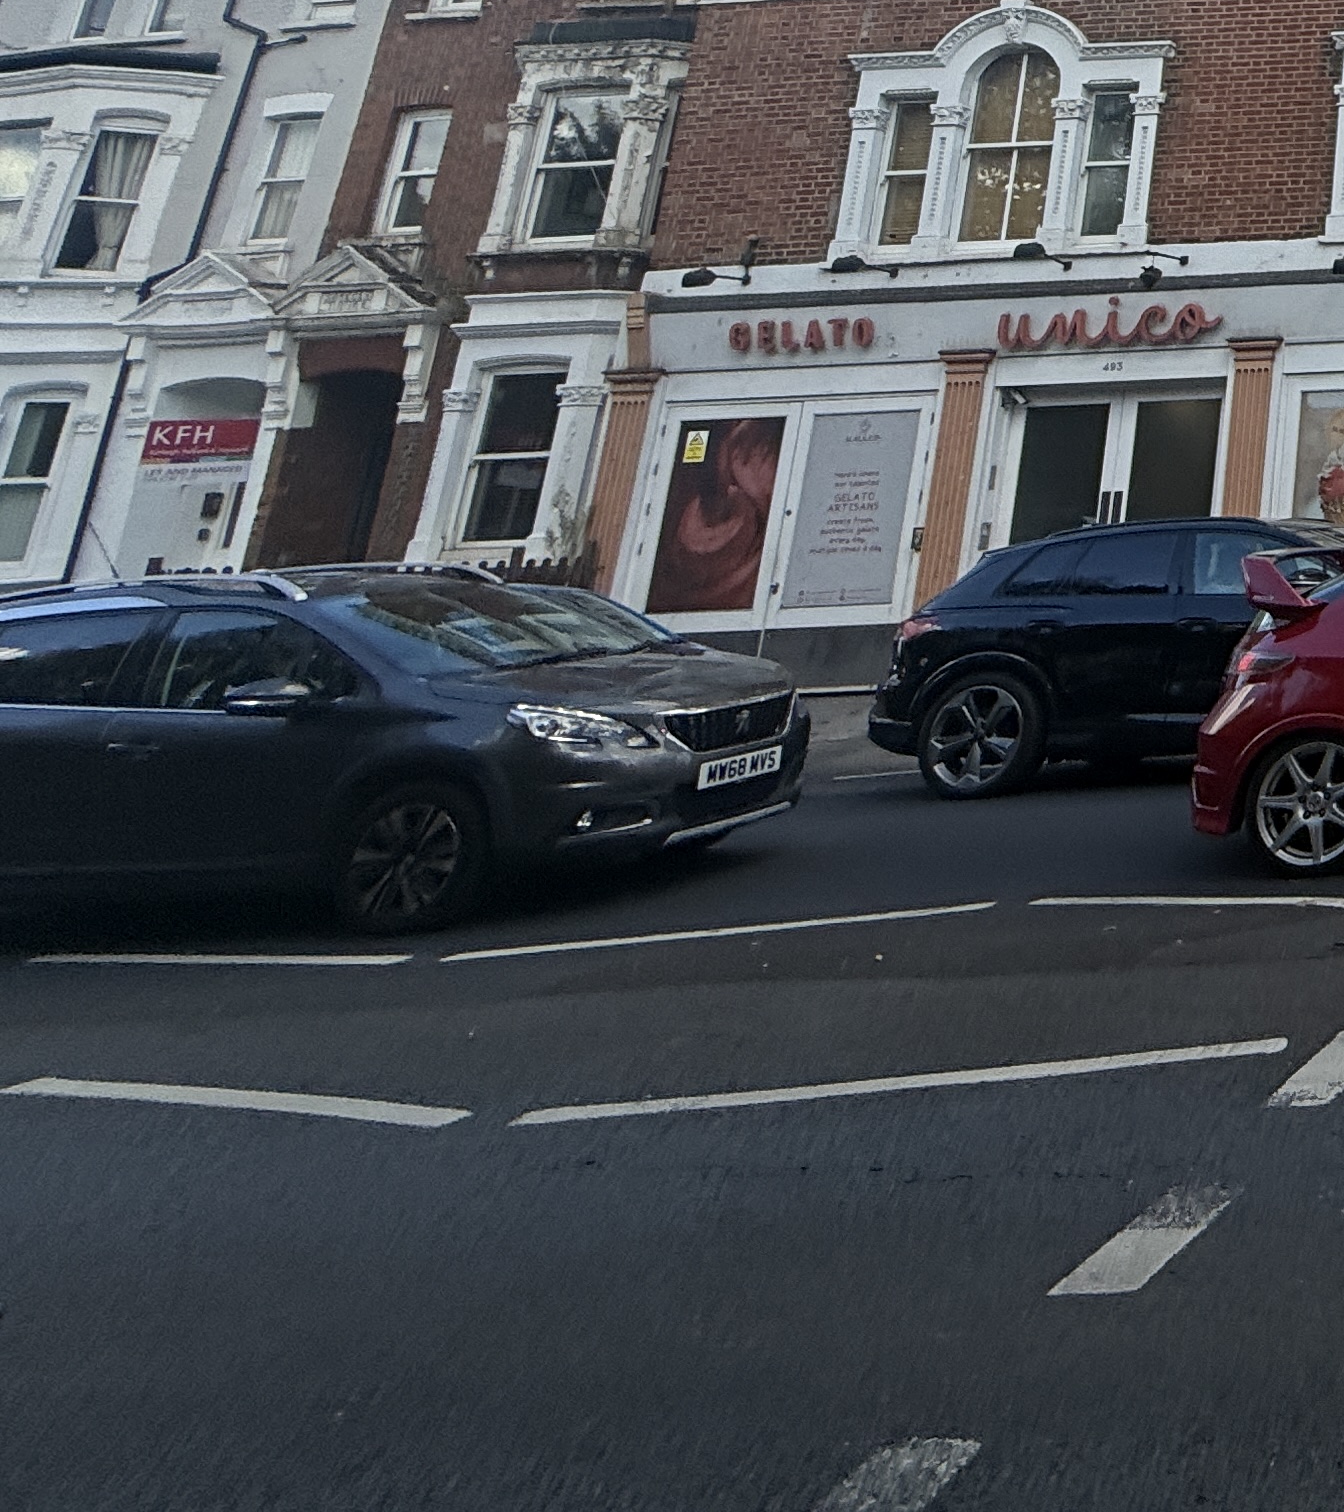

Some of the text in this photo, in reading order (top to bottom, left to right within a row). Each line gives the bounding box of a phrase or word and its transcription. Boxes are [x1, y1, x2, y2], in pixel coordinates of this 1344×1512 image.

[998, 296, 1223, 349] unico
[729, 317, 875, 353] GELATO
[152, 425, 215, 446] KFH
[827, 502, 879, 512] ARTISANS
[834, 492, 875, 502] GELATO
